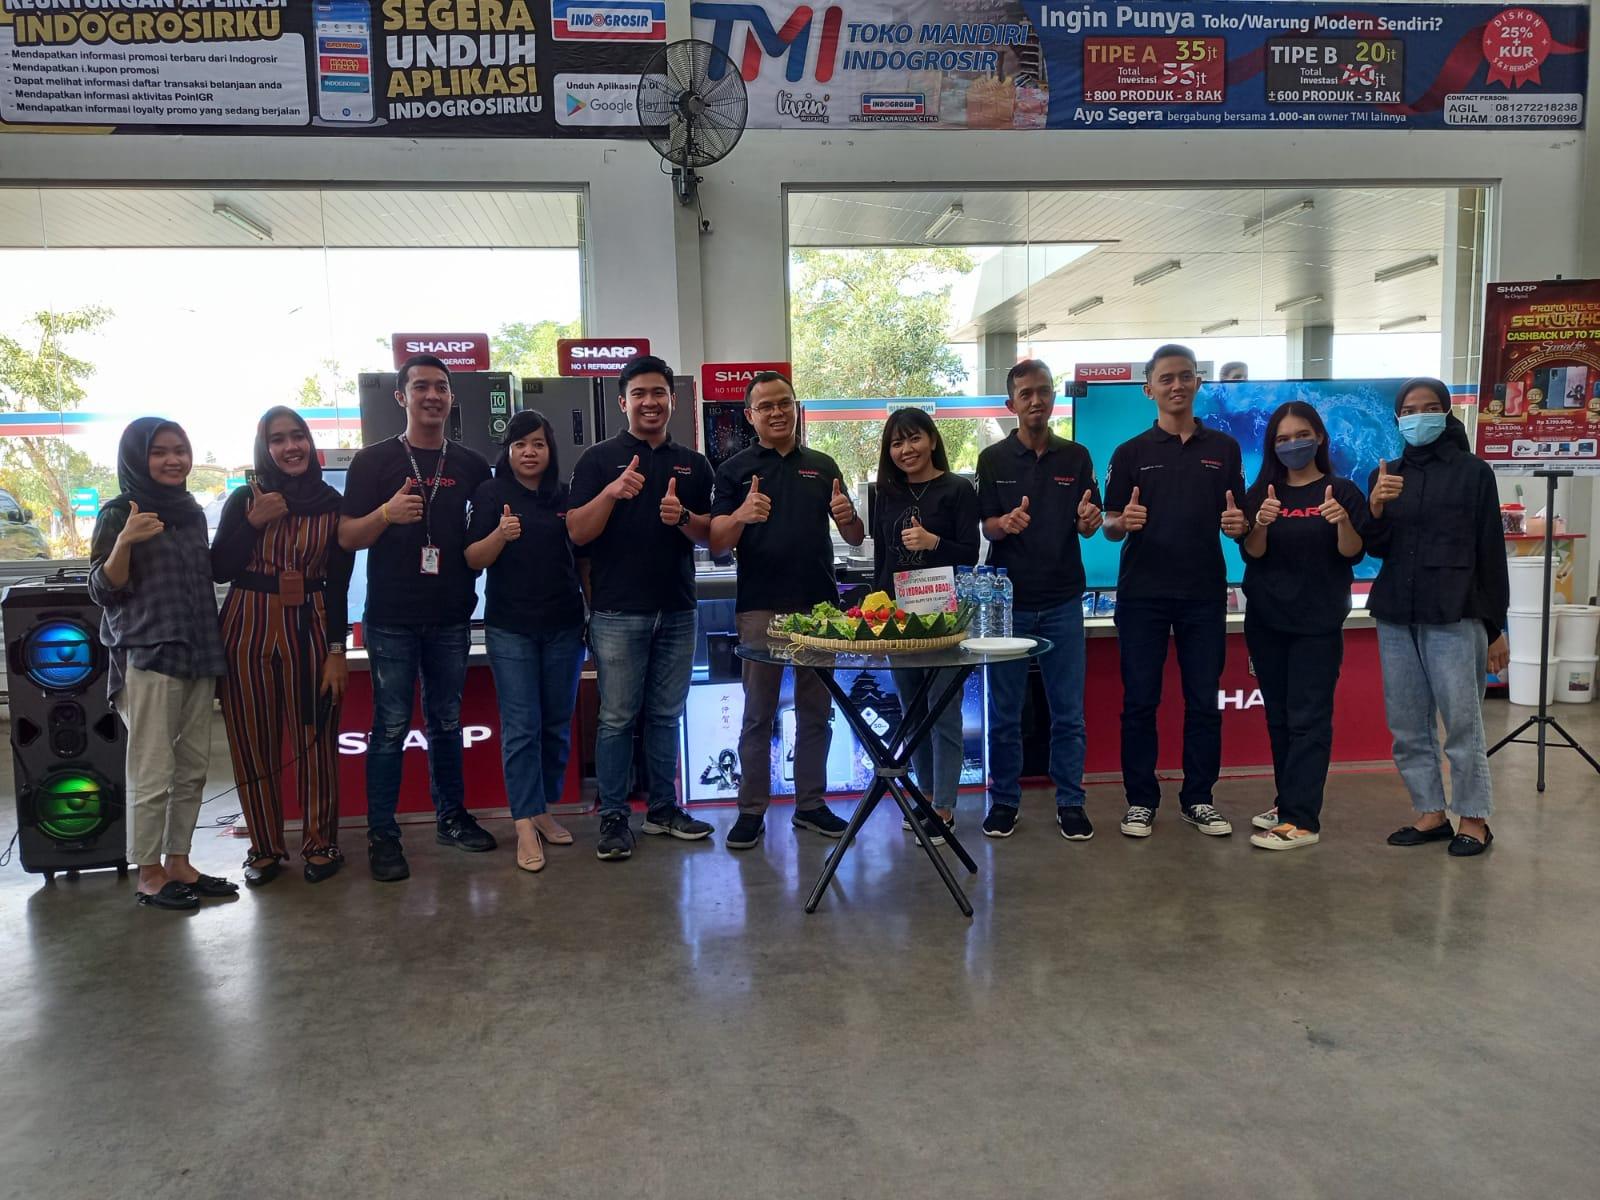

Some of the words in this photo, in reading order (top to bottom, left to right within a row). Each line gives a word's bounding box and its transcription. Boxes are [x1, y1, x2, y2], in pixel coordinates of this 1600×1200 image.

[382, 0, 535, 30] SEGERA
[570, 13, 648, 28] INDOGROSIR
[1041, 5, 1108, 34] Ingin
[1116, 6, 1194, 34] Punya
[1202, 14, 1310, 32] Toko/Warung
[1314, 16, 1374, 30] Modern
[1377, 16, 1444, 31] Sendiri?
[1494, 11, 1542, 28] DISKON
[15, 9, 280, 42] INDOGROSIRKU
[847, 22, 914, 45] TOKO
[919, 23, 1029, 46] MANDIRI
[1500, 26, 1534, 38] 25%
[691, 4, 842, 82] TMI
[12, 50, 78, 60] Mendapatkan
[80, 51, 126, 60] informasi
[128, 53, 168, 62] promosi
[170, 54, 206, 62] terbaru
[208, 54, 228, 62] dari
[230, 55, 278, 64] Indogrosir
[386, 34, 536, 69] UNDUH
[1087, 45, 1136, 63] TIPE
[1141, 45, 1158, 64] A
[1270, 46, 1318, 64] TIPE
[1324, 47, 1338, 64] B
[1499, 46, 1534, 58] KUR
[842, 50, 998, 71] INDOGROSIR
[13, 63, 79, 73] Mendapatkan
[120, 66, 160, 75] promosi
[1118, 66, 1140, 76] Total
[1300, 68, 1322, 76] Total
[14, 76, 44, 86] Dapat
[46, 78, 82, 86] melihat
[84, 78, 130, 88] informasi
[132, 79, 162, 88] daftar
[164, 80, 208, 89] transaksi
[210, 81, 256, 90] belanjaan
[258, 82, 282, 90] anda
[387, 66, 538, 98] APLIKASI
[566, 82, 594, 90] Unduh
[1118, 76, 1157, 84] Investasi
[1300, 76, 1338, 84] Investasi
[15, 90, 82, 100] Mendapatkan
[84, 91, 130, 100] informasi
[132, 92, 172, 101] aktivitas
[1120, 90, 1174, 101] PRODUK
[1185, 91, 1192, 101] 8
[1196, 90, 1222, 101] RAK
[1302, 90, 1354, 101] PRODUK
[1365, 92, 1372, 101] 5
[1375, 91, 1400, 102] RAK
[16, 103, 82, 114] Mendapatkan
[85, 104, 130, 114] informasi
[133, 105, 164, 116] loyalty
[166, 107, 198, 116] promo
[200, 108, 222, 116] yang
[224, 106, 260, 116] sedang
[262, 107, 300, 116] berjalan
[389, 96, 542, 120] INDOGROSIRKU
[590, 98, 633, 114] Google
[1448, 104, 1478, 113] AGIL
[1496, 103, 1578, 112] 081272218238
[1074, 108, 1104, 124] Ayo
[1108, 108, 1163, 124] Segera
[1168, 112, 1222, 124] bergabung
[1224, 112, 1266, 121] bersama
[1269, 112, 1315, 121] 1.000-an
[1318, 114, 1348, 122] owner
[1350, 112, 1368, 122] TMI
[1371, 112, 1406, 124] lainnya
[1448, 114, 1488, 124] ILHAM
[1494, 114, 1577, 124] 081376709696
[1496, 285, 1537, 293] SHARP
[1530, 304, 1566, 313] PROMO
[1506, 332, 1558, 341] CASHBACK
[1560, 330, 1572, 340] UP
[1574, 330, 1588, 339] TO
[406, 342, 475, 352] SHARP
[570, 346, 638, 358] SHARP
[715, 370, 778, 382] SHA
[1080, 368, 1126, 376] SHARP
[492, 394, 504, 409] 10
[338, 726, 492, 754] SAP
